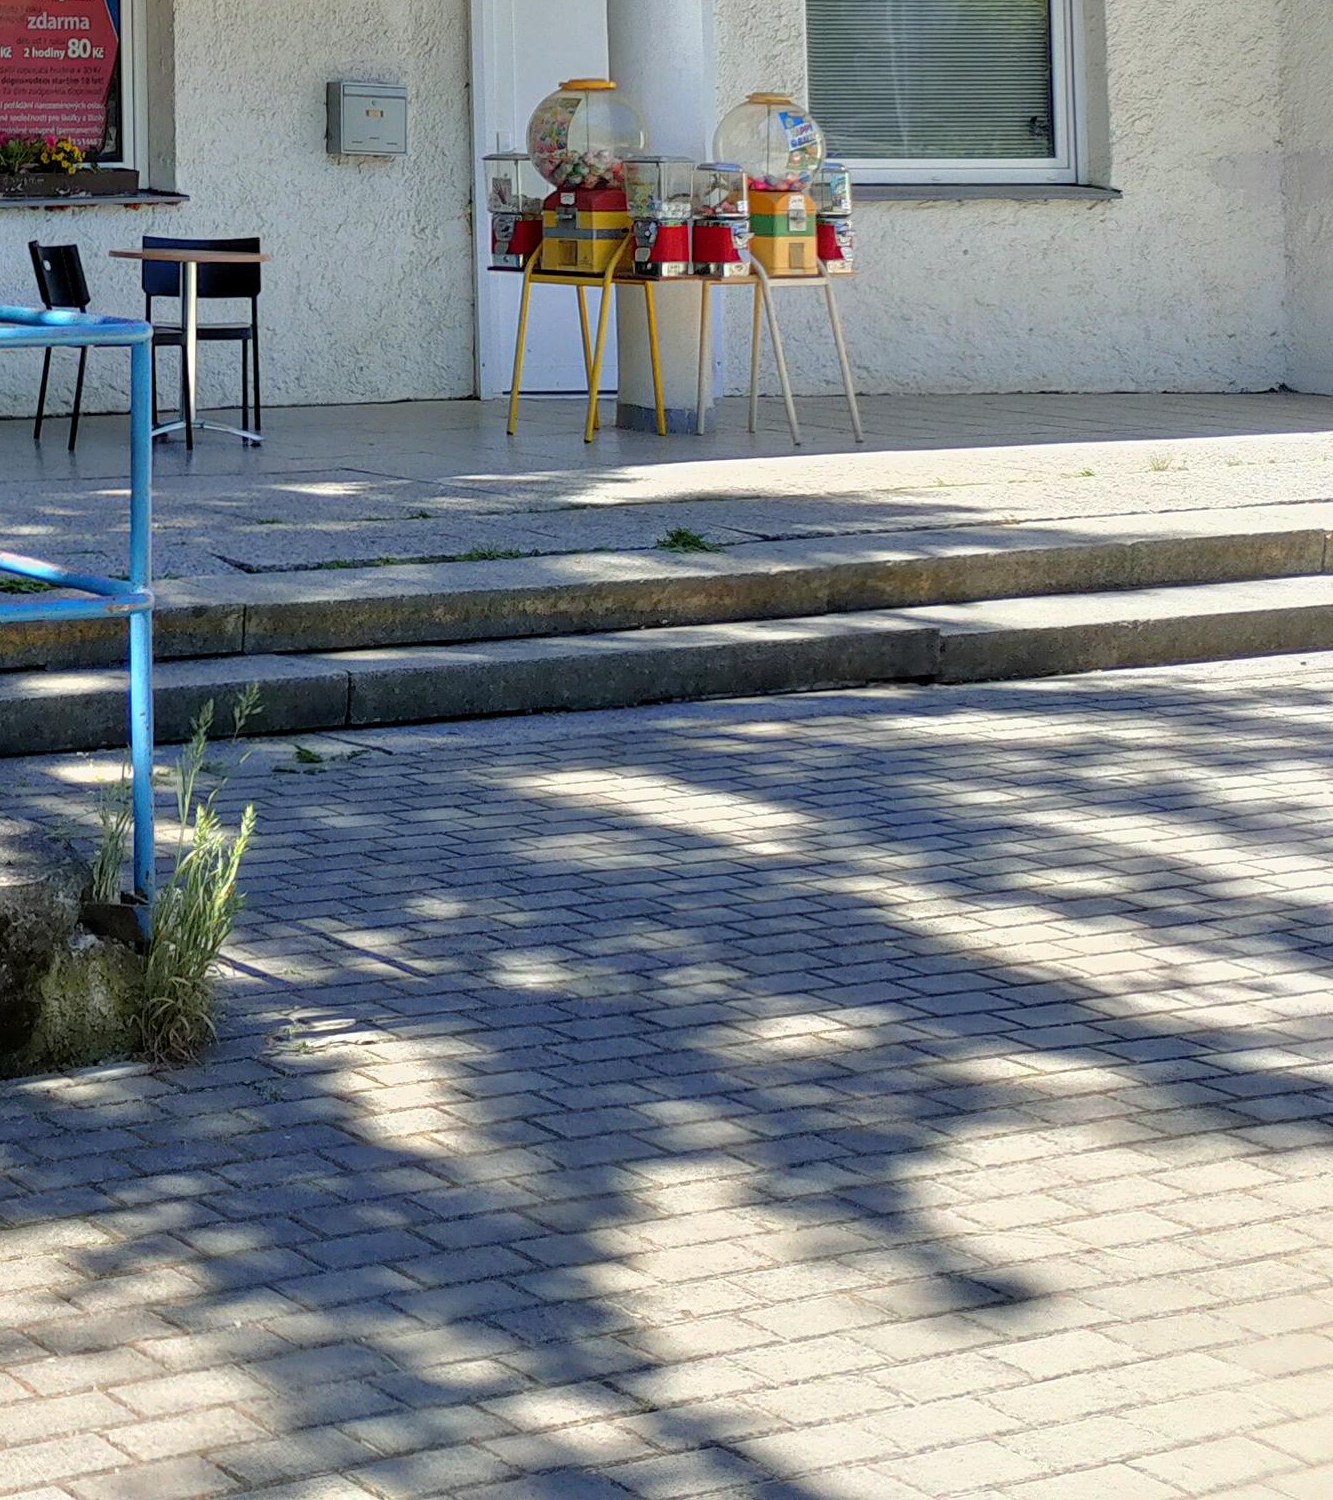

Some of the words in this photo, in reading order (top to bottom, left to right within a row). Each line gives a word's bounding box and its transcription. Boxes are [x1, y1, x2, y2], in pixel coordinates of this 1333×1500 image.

[27, 12, 90, 30] zdarma
[0, 47, 12, 58] Kč
[24, 48, 30, 57] 2
[32, 47, 65, 60] hodiny
[67, 38, 91, 58] 80
[92, 47, 104, 58] Kč
